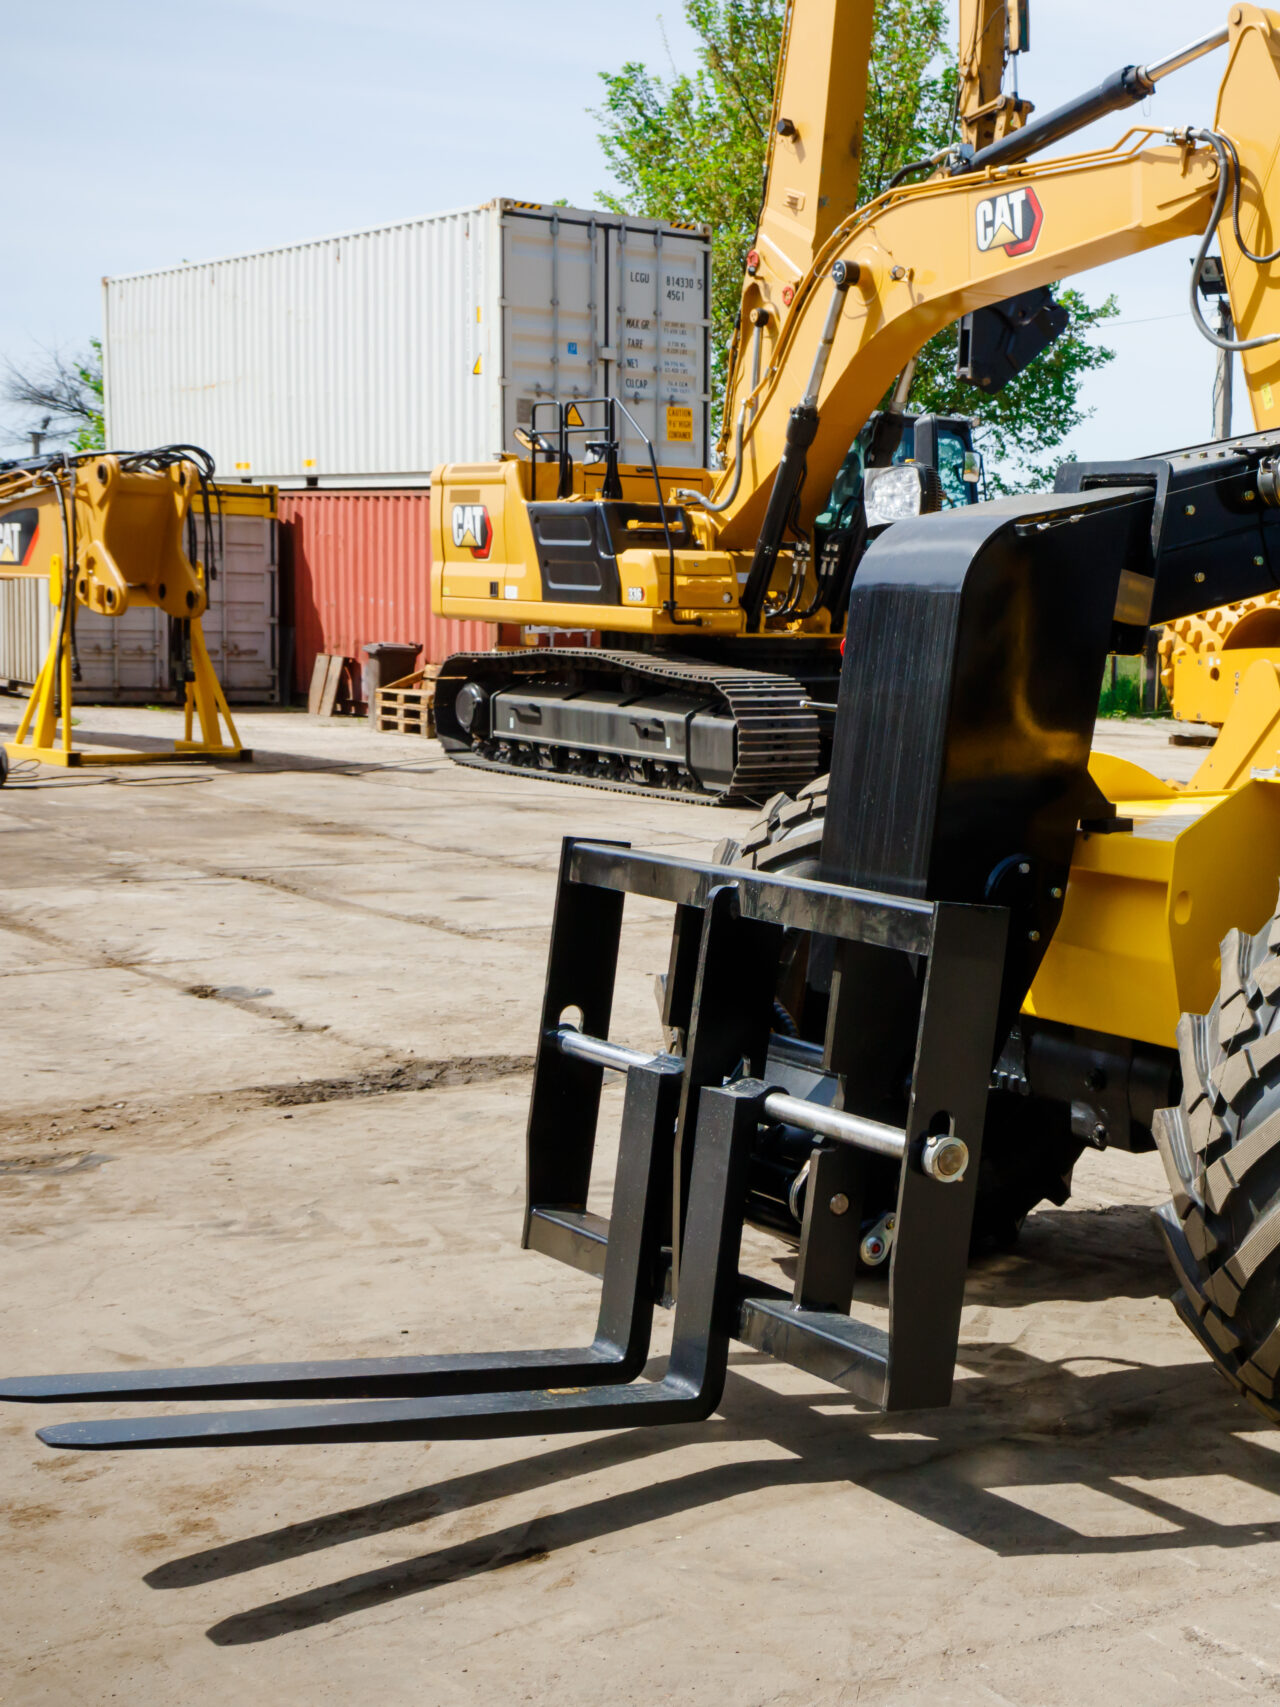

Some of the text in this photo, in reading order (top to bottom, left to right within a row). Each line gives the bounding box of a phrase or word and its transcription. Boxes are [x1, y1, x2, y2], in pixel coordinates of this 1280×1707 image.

[976, 188, 1026, 251] CAT
[630, 271, 703, 291] LCGU 814330 5
[666, 289, 685, 302] 45G1
[627, 338, 643, 350] TARE
[626, 358, 639, 369] NET
[453, 505, 484, 547] CAT
